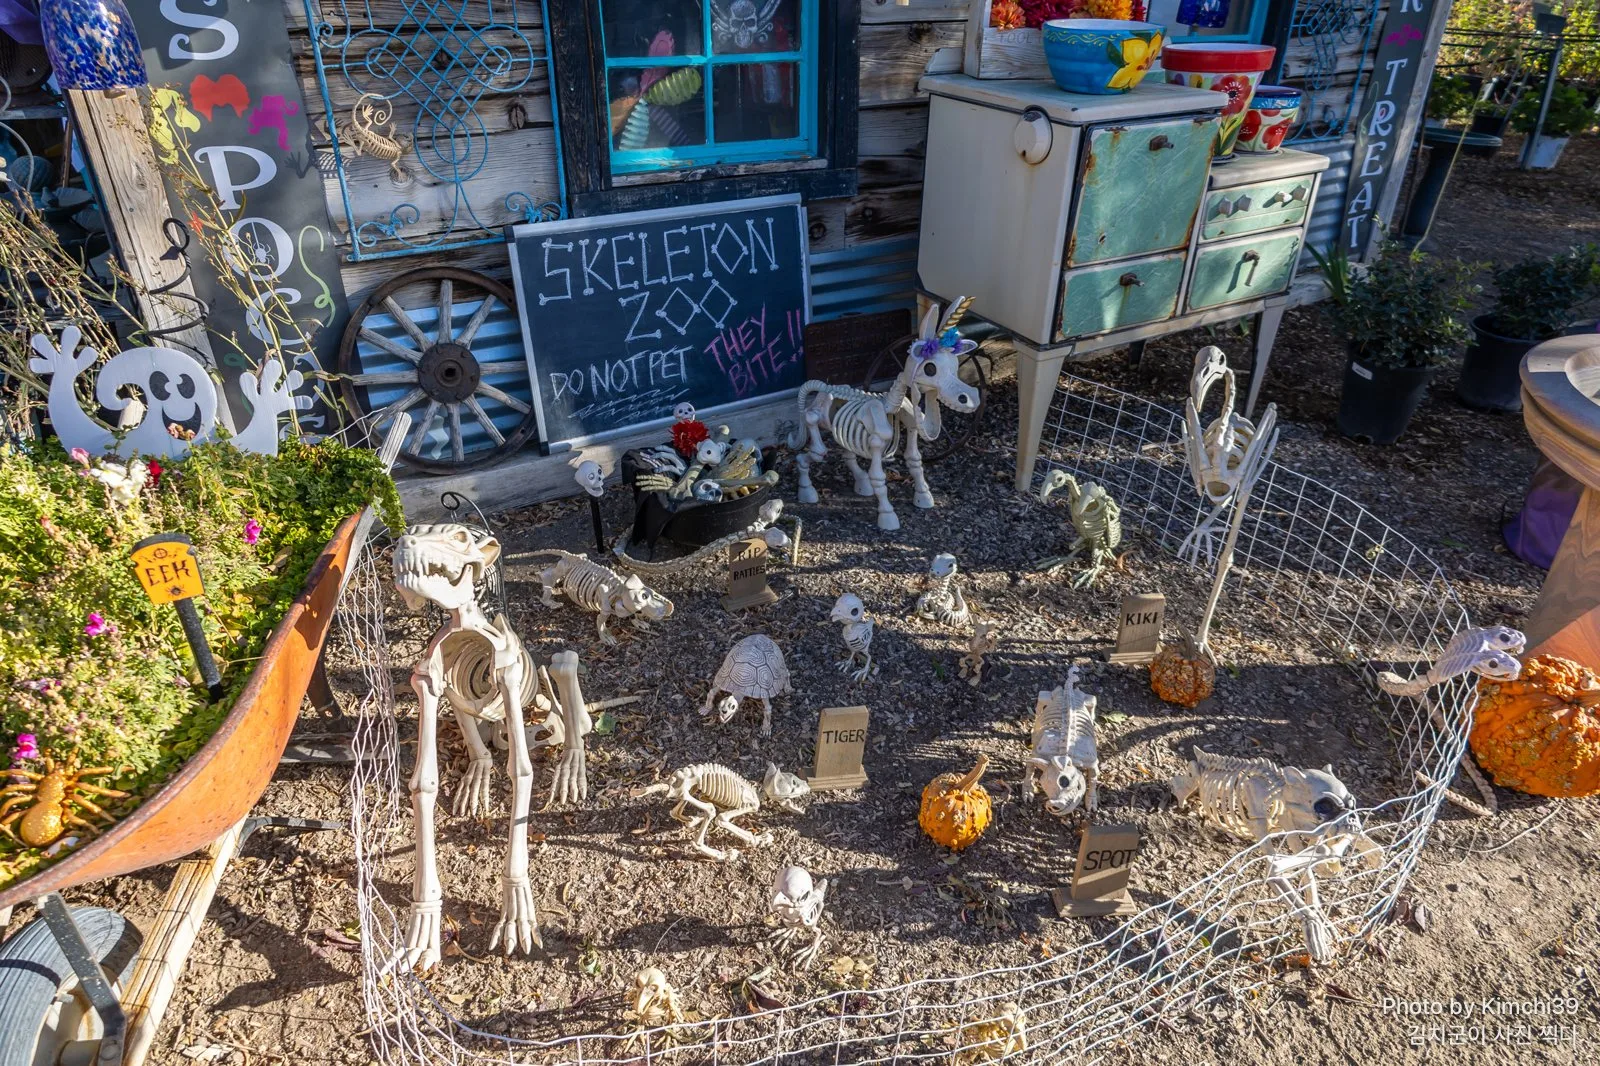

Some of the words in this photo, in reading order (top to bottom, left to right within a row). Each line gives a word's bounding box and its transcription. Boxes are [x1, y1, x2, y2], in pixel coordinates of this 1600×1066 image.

[1347, 58, 1408, 248] TREAT
[539, 217, 779, 305] SKELETON
[618, 279, 738, 343] ZOO
[703, 301, 766, 375] THEY
[549, 369, 584, 401] DO
[590, 350, 651, 399] NOT
[648, 344, 694, 386] PET
[145, 559, 192, 587] EEK
[1125, 611, 1158, 626] KIKI
[822, 728, 865, 744] TIGER
[1083, 849, 1136, 871] SPOT
